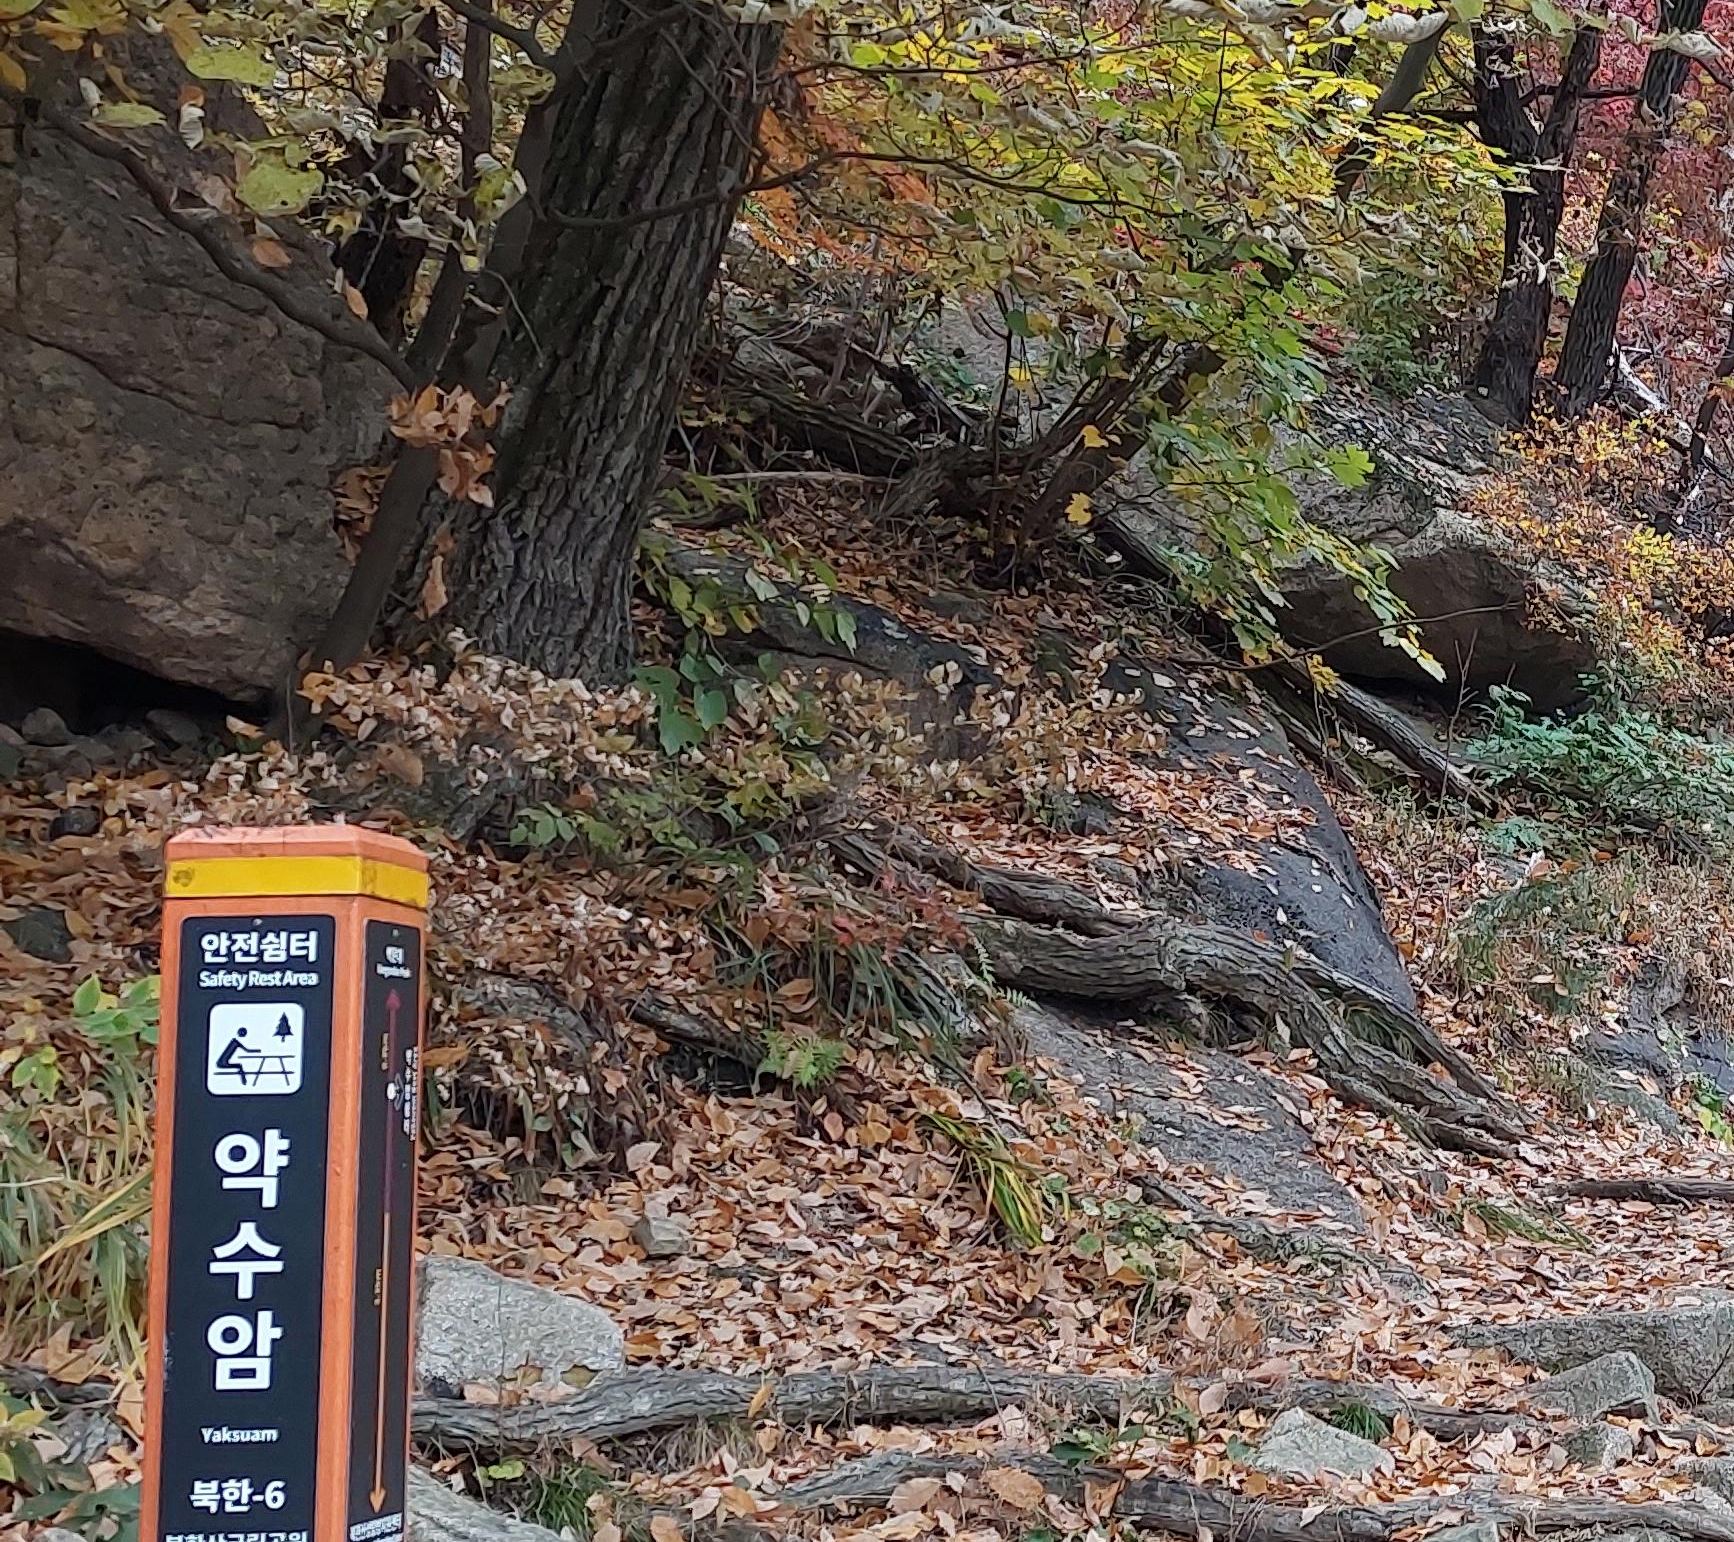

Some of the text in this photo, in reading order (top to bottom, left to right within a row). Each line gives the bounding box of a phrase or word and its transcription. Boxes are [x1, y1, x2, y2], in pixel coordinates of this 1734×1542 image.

[200, 931, 319, 963] 안전쉼터
[199, 970, 319, 991] Safety Rest Area
[207, 1128, 291, 1391] 약수암
[201, 1426, 280, 1444] Yaksuam
[189, 1478, 286, 1514] 북한-6
